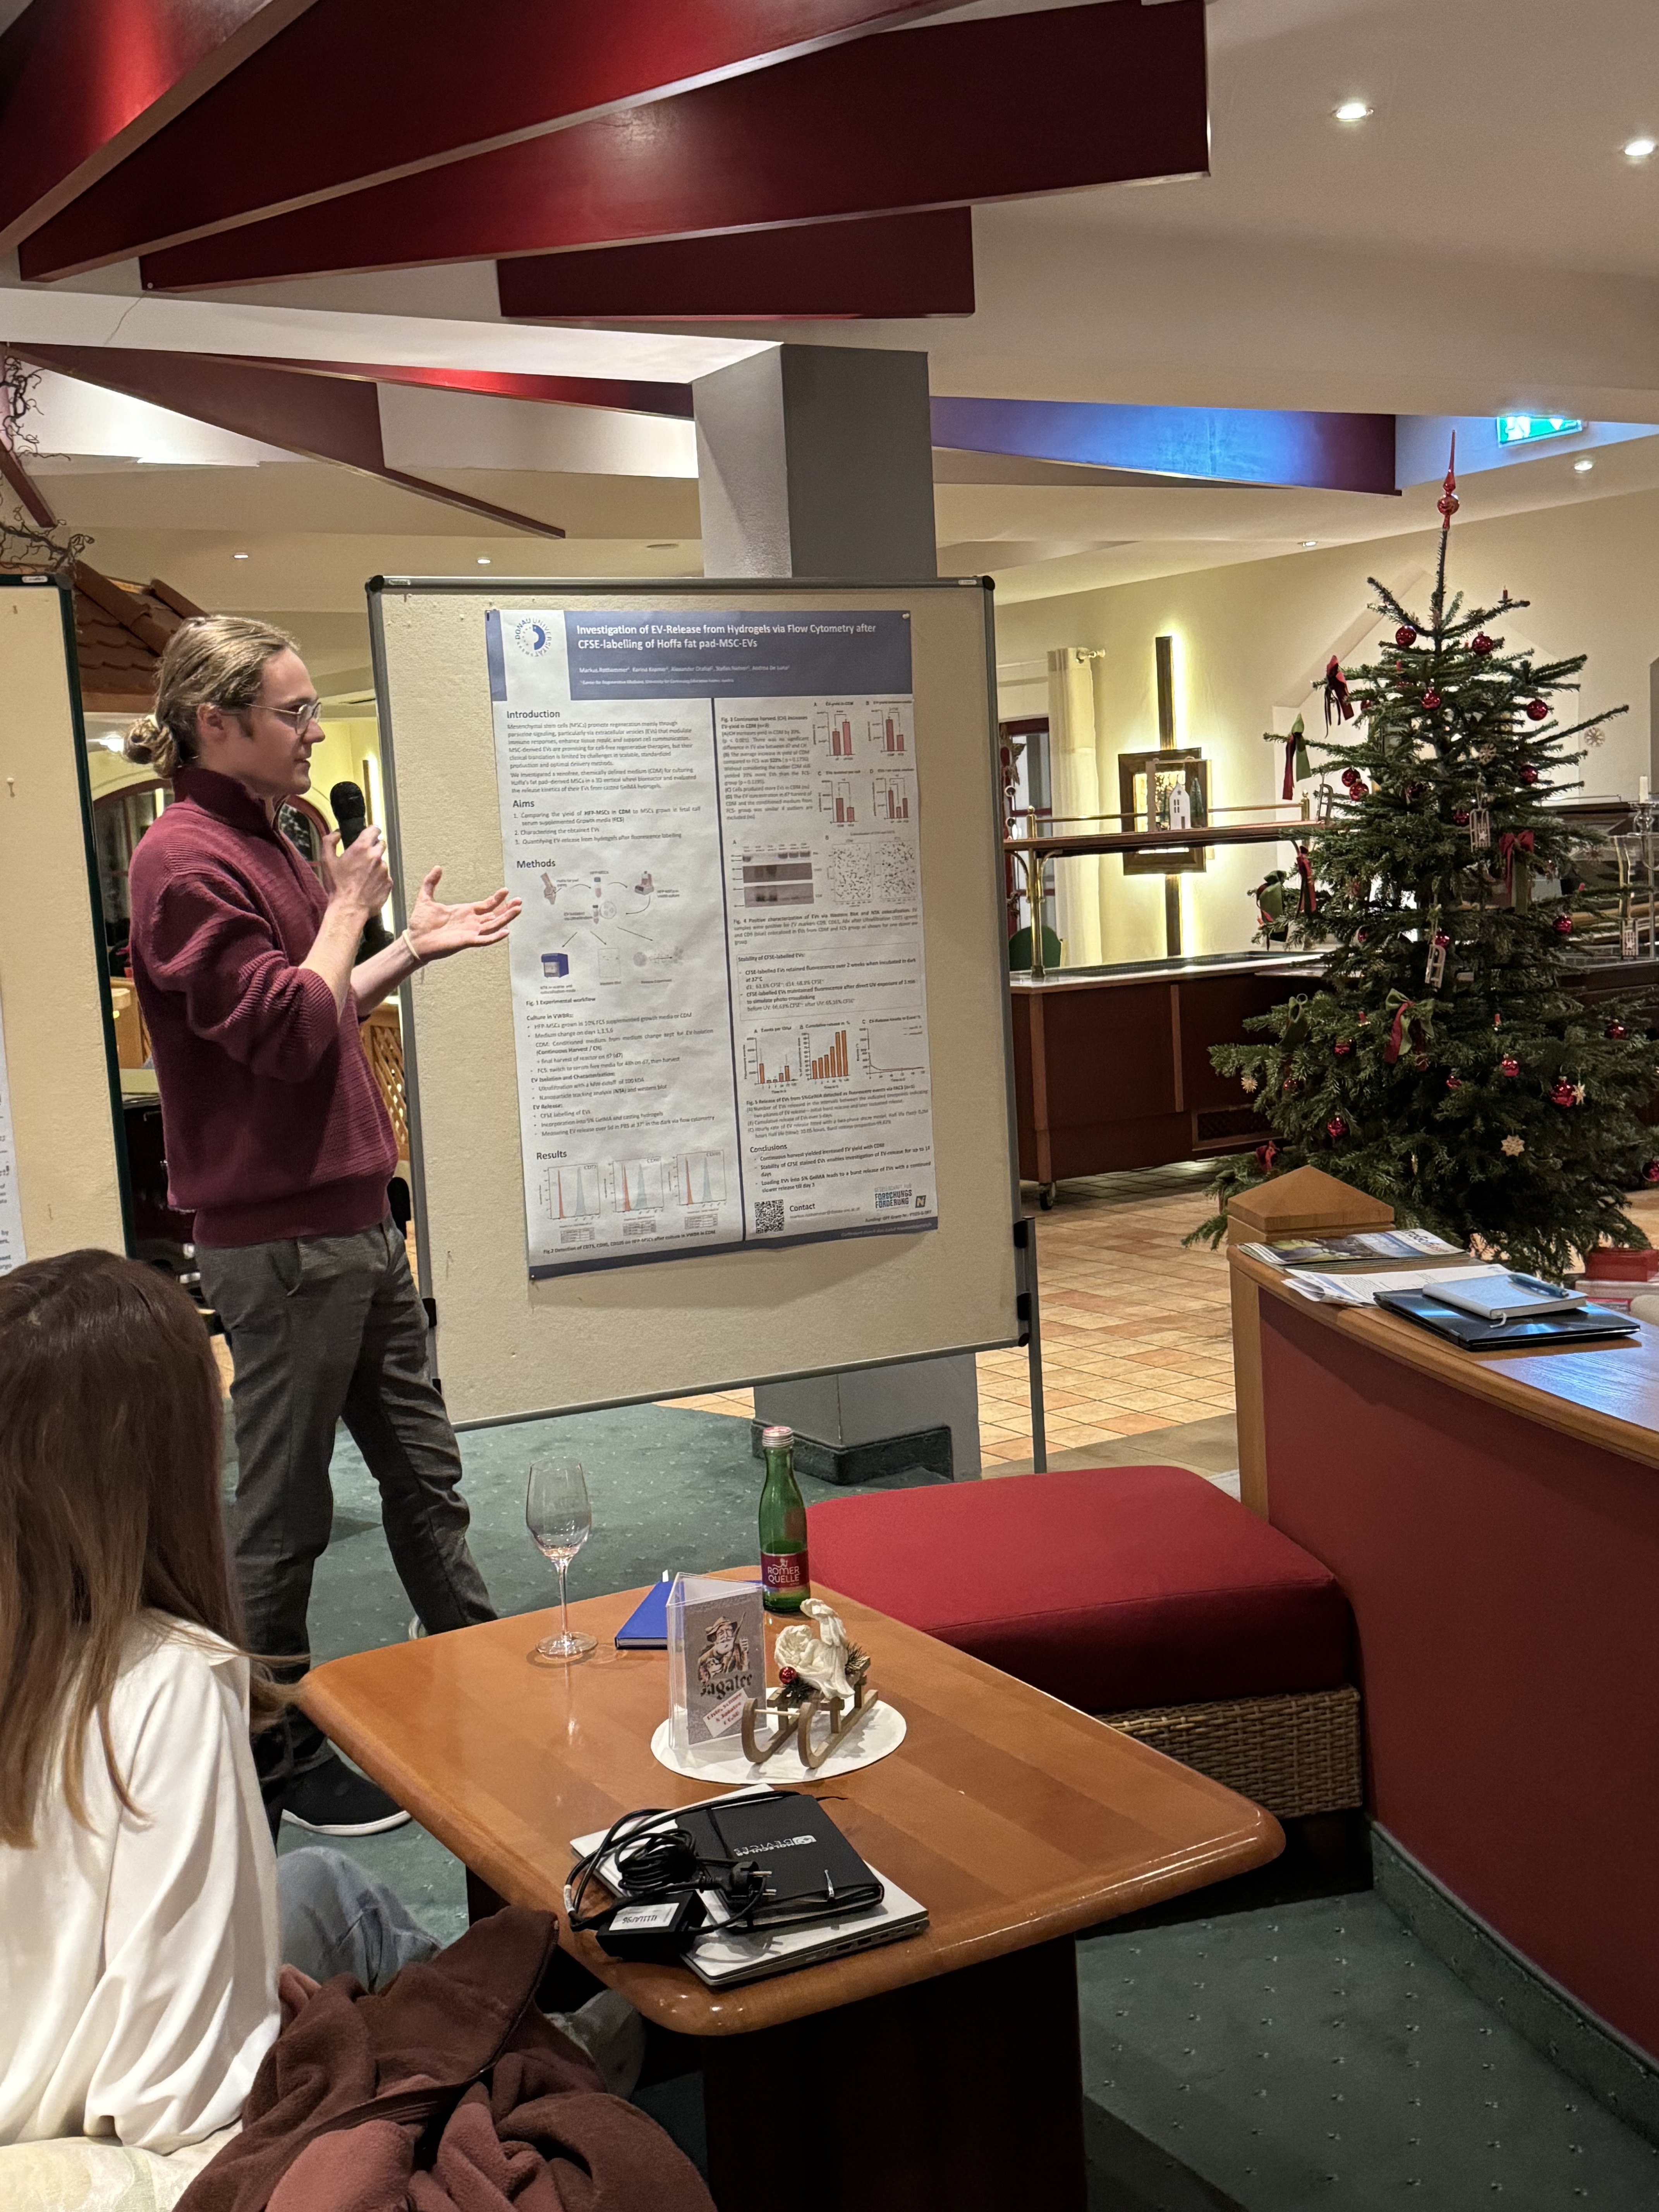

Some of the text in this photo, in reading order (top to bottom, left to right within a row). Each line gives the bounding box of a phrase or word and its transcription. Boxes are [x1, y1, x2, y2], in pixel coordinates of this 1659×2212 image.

[576, 622, 875, 635] Investigation of EV-Release from Hydrogels via Flow Cytometry after
[578, 639, 757, 649] CFSE-labelling of Hoffa fat pad-MSC-EVs
[507, 710, 560, 718] Introduction
[512, 799, 534, 808] Aims
[516, 859, 556, 869] Methods
[750, 1142, 787, 1154] Conclusions
[536, 1149, 567, 1161] Results
[789, 1202, 815, 1212] Contact
[768, 1575, 799, 1584] QUELLE
